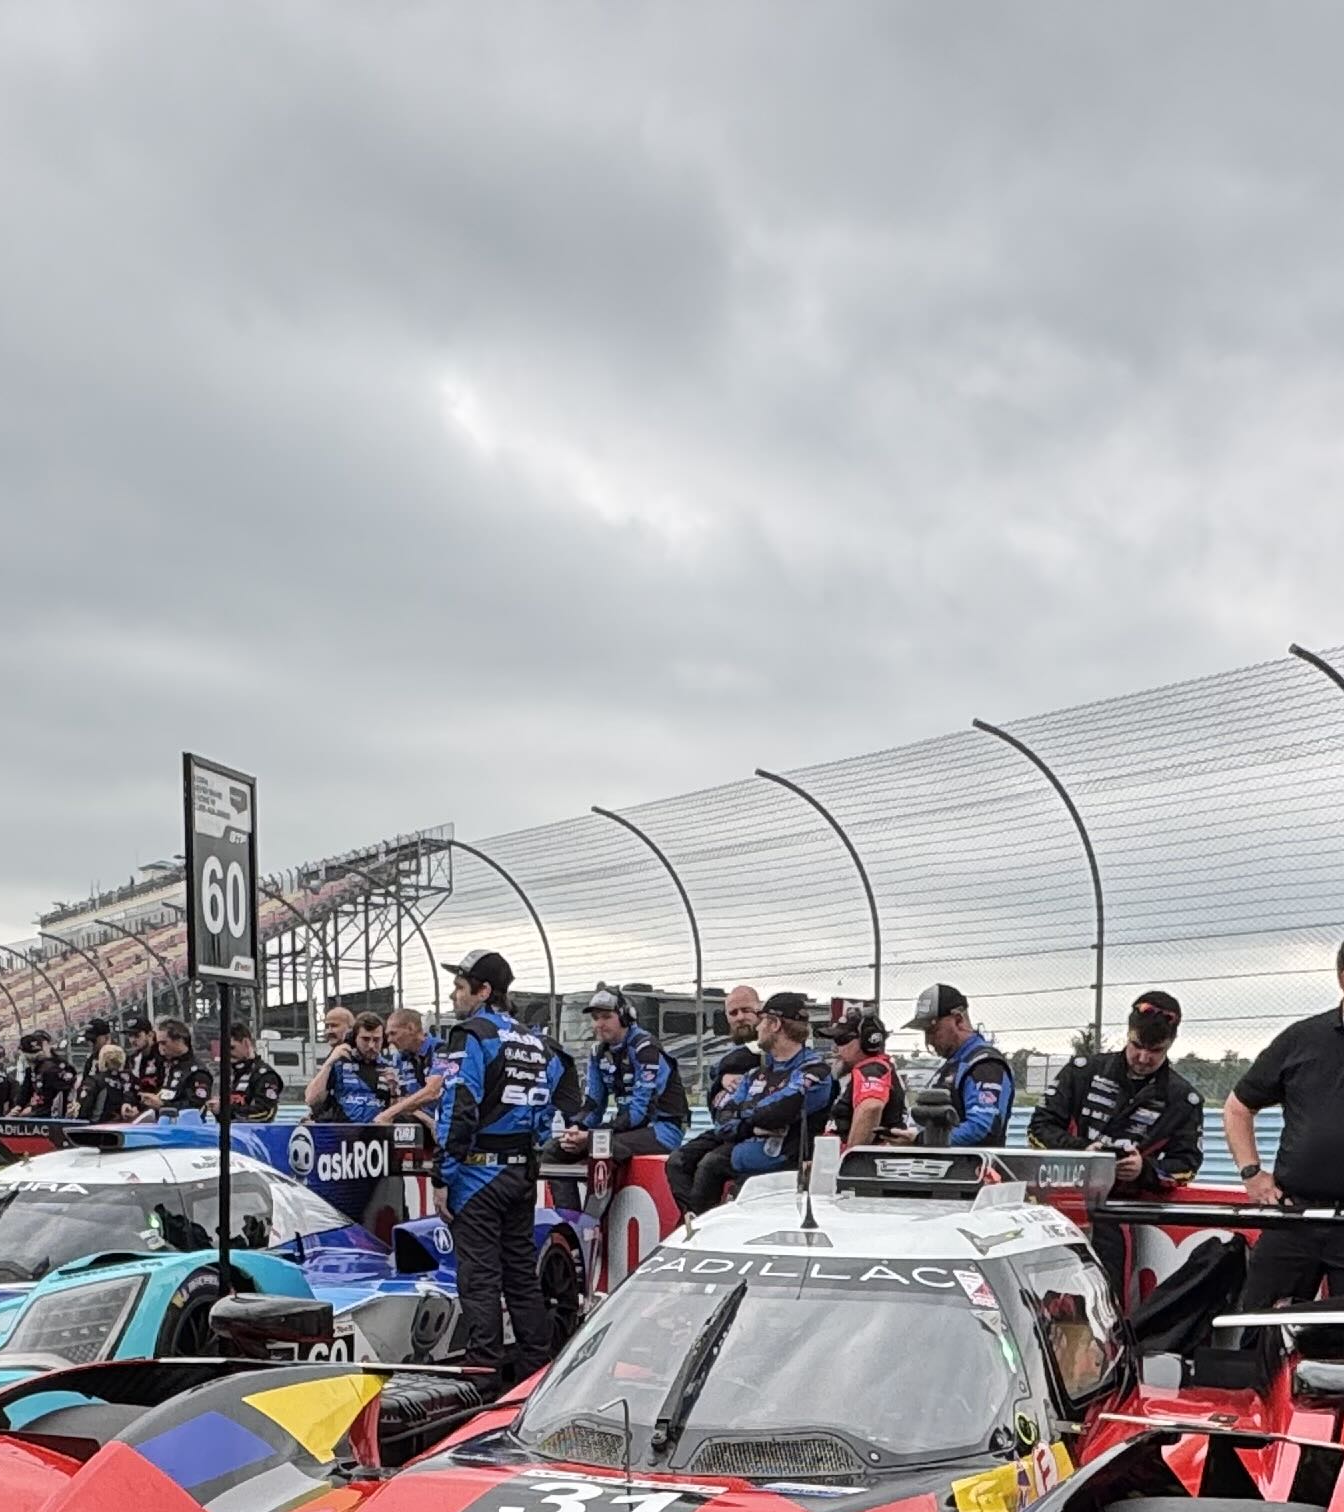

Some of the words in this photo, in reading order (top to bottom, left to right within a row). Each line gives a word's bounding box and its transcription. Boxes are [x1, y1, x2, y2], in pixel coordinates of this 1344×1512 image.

[202, 855, 246, 938] 60
[501, 1084, 550, 1106] 60
[317, 1139, 389, 1182] askROI
[1038, 1163, 1086, 1188] CADILLAC
[636, 1256, 956, 1288] CADILLAC
